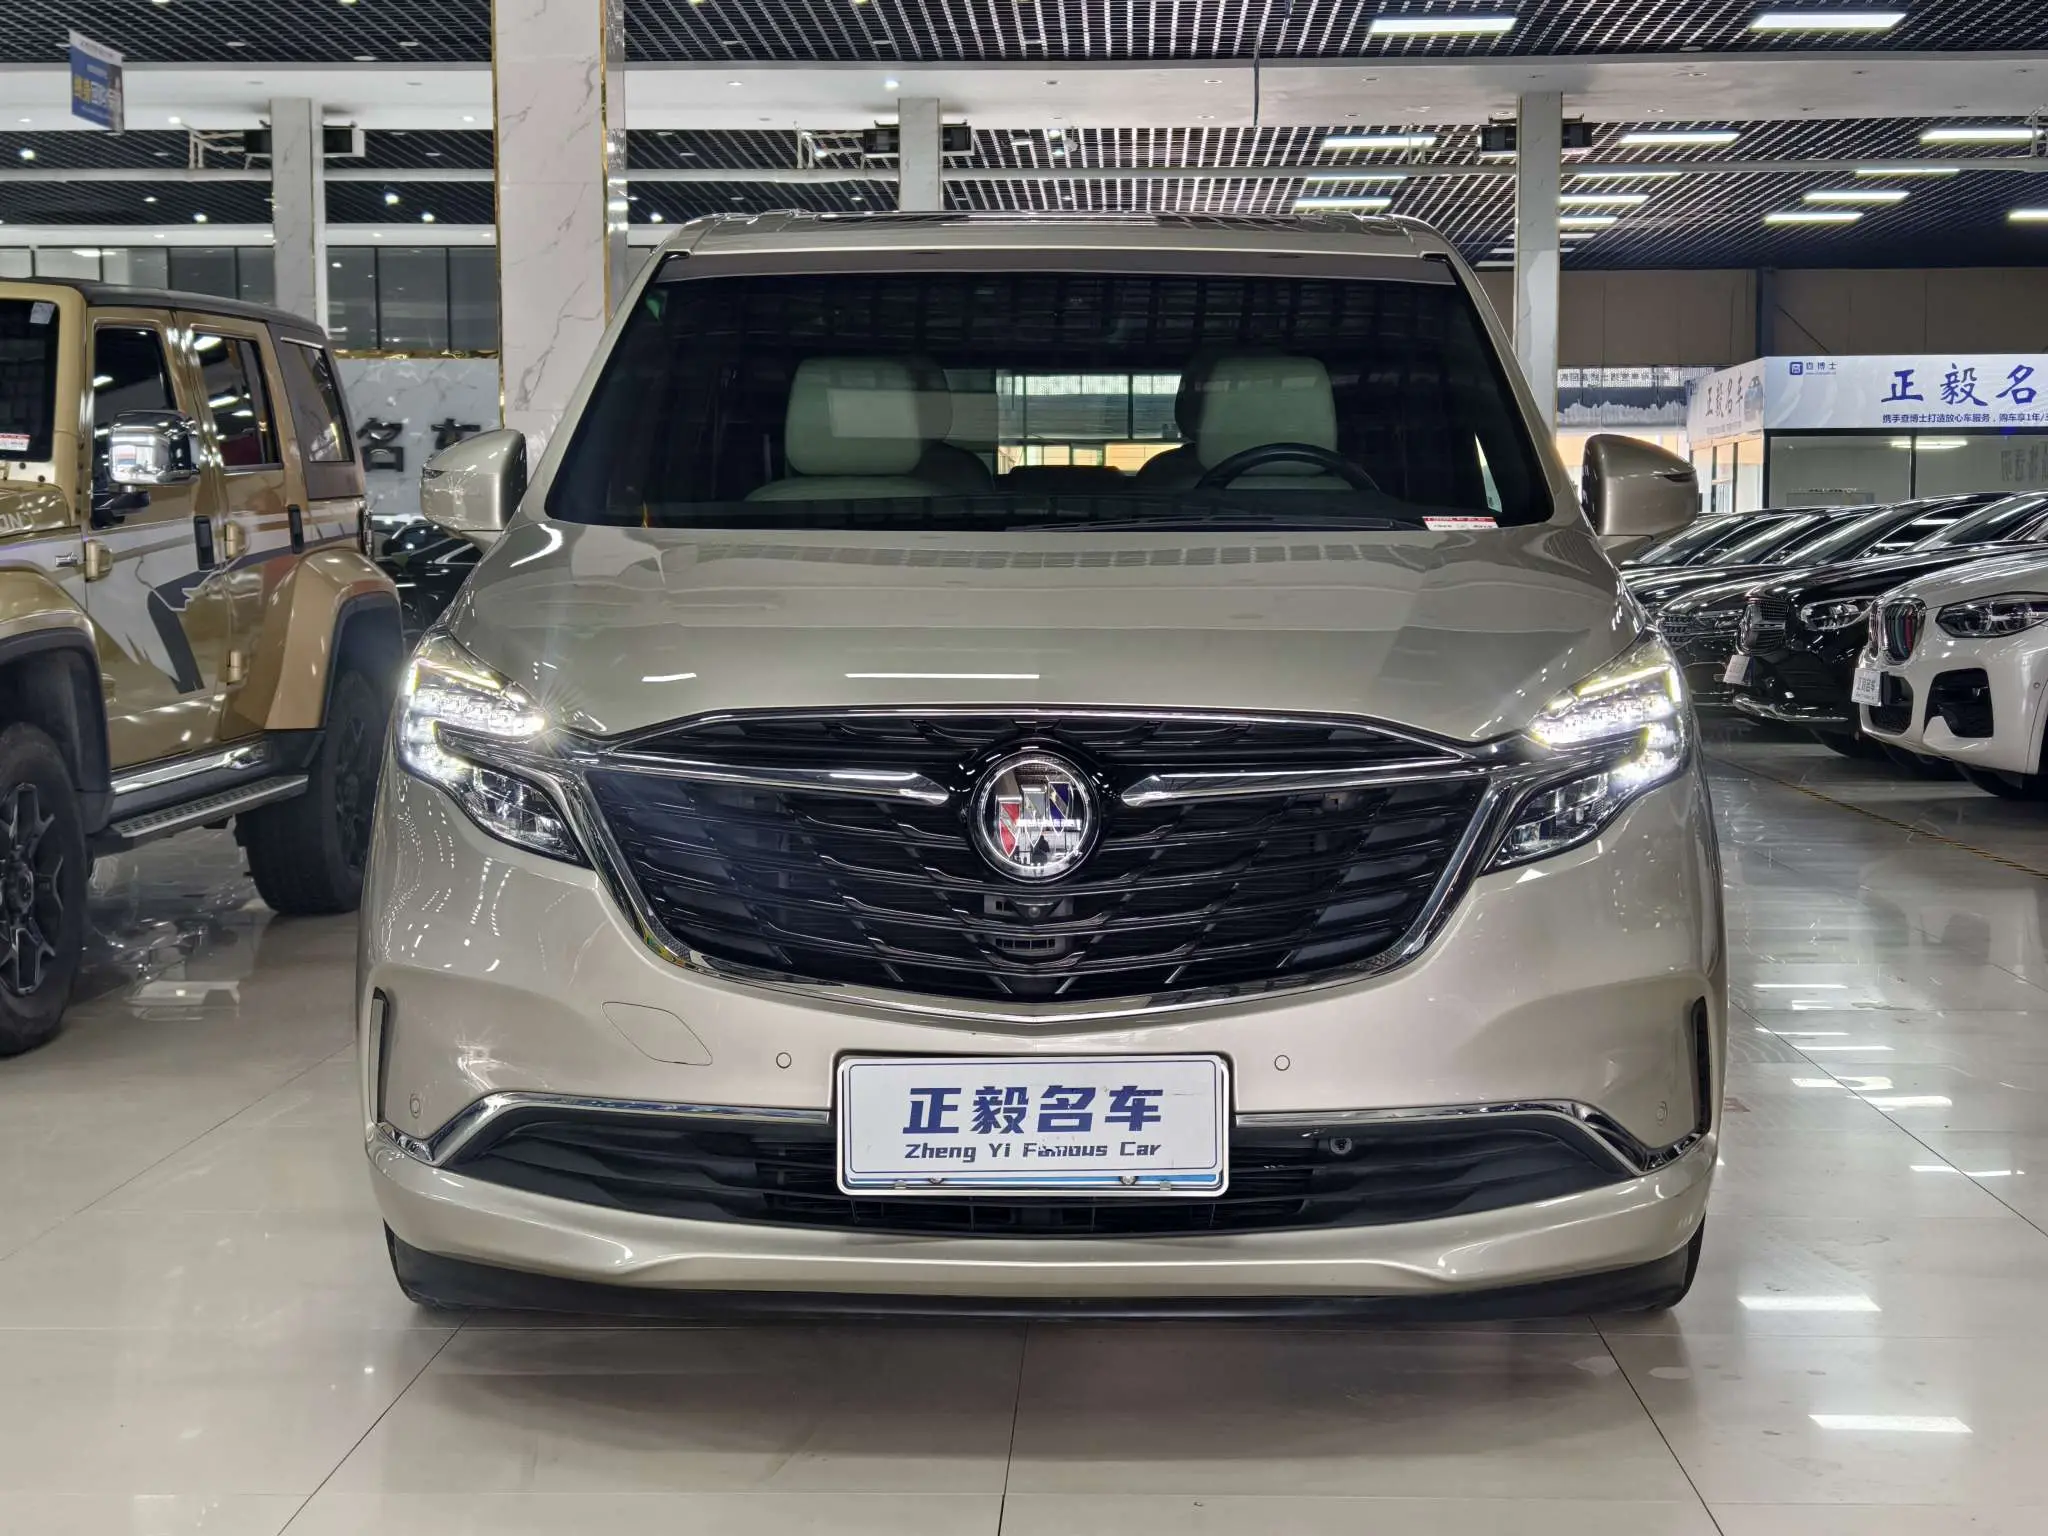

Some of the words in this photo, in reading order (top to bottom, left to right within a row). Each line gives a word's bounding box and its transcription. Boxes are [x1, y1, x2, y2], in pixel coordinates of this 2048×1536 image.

[1881, 363, 2037, 407] 正毅名
[902, 1085, 1164, 1135] 正毅名车
[904, 1143, 977, 1163] Zheng
[988, 1143, 1011, 1158] Yi
[1119, 1141, 1162, 1157] Car
